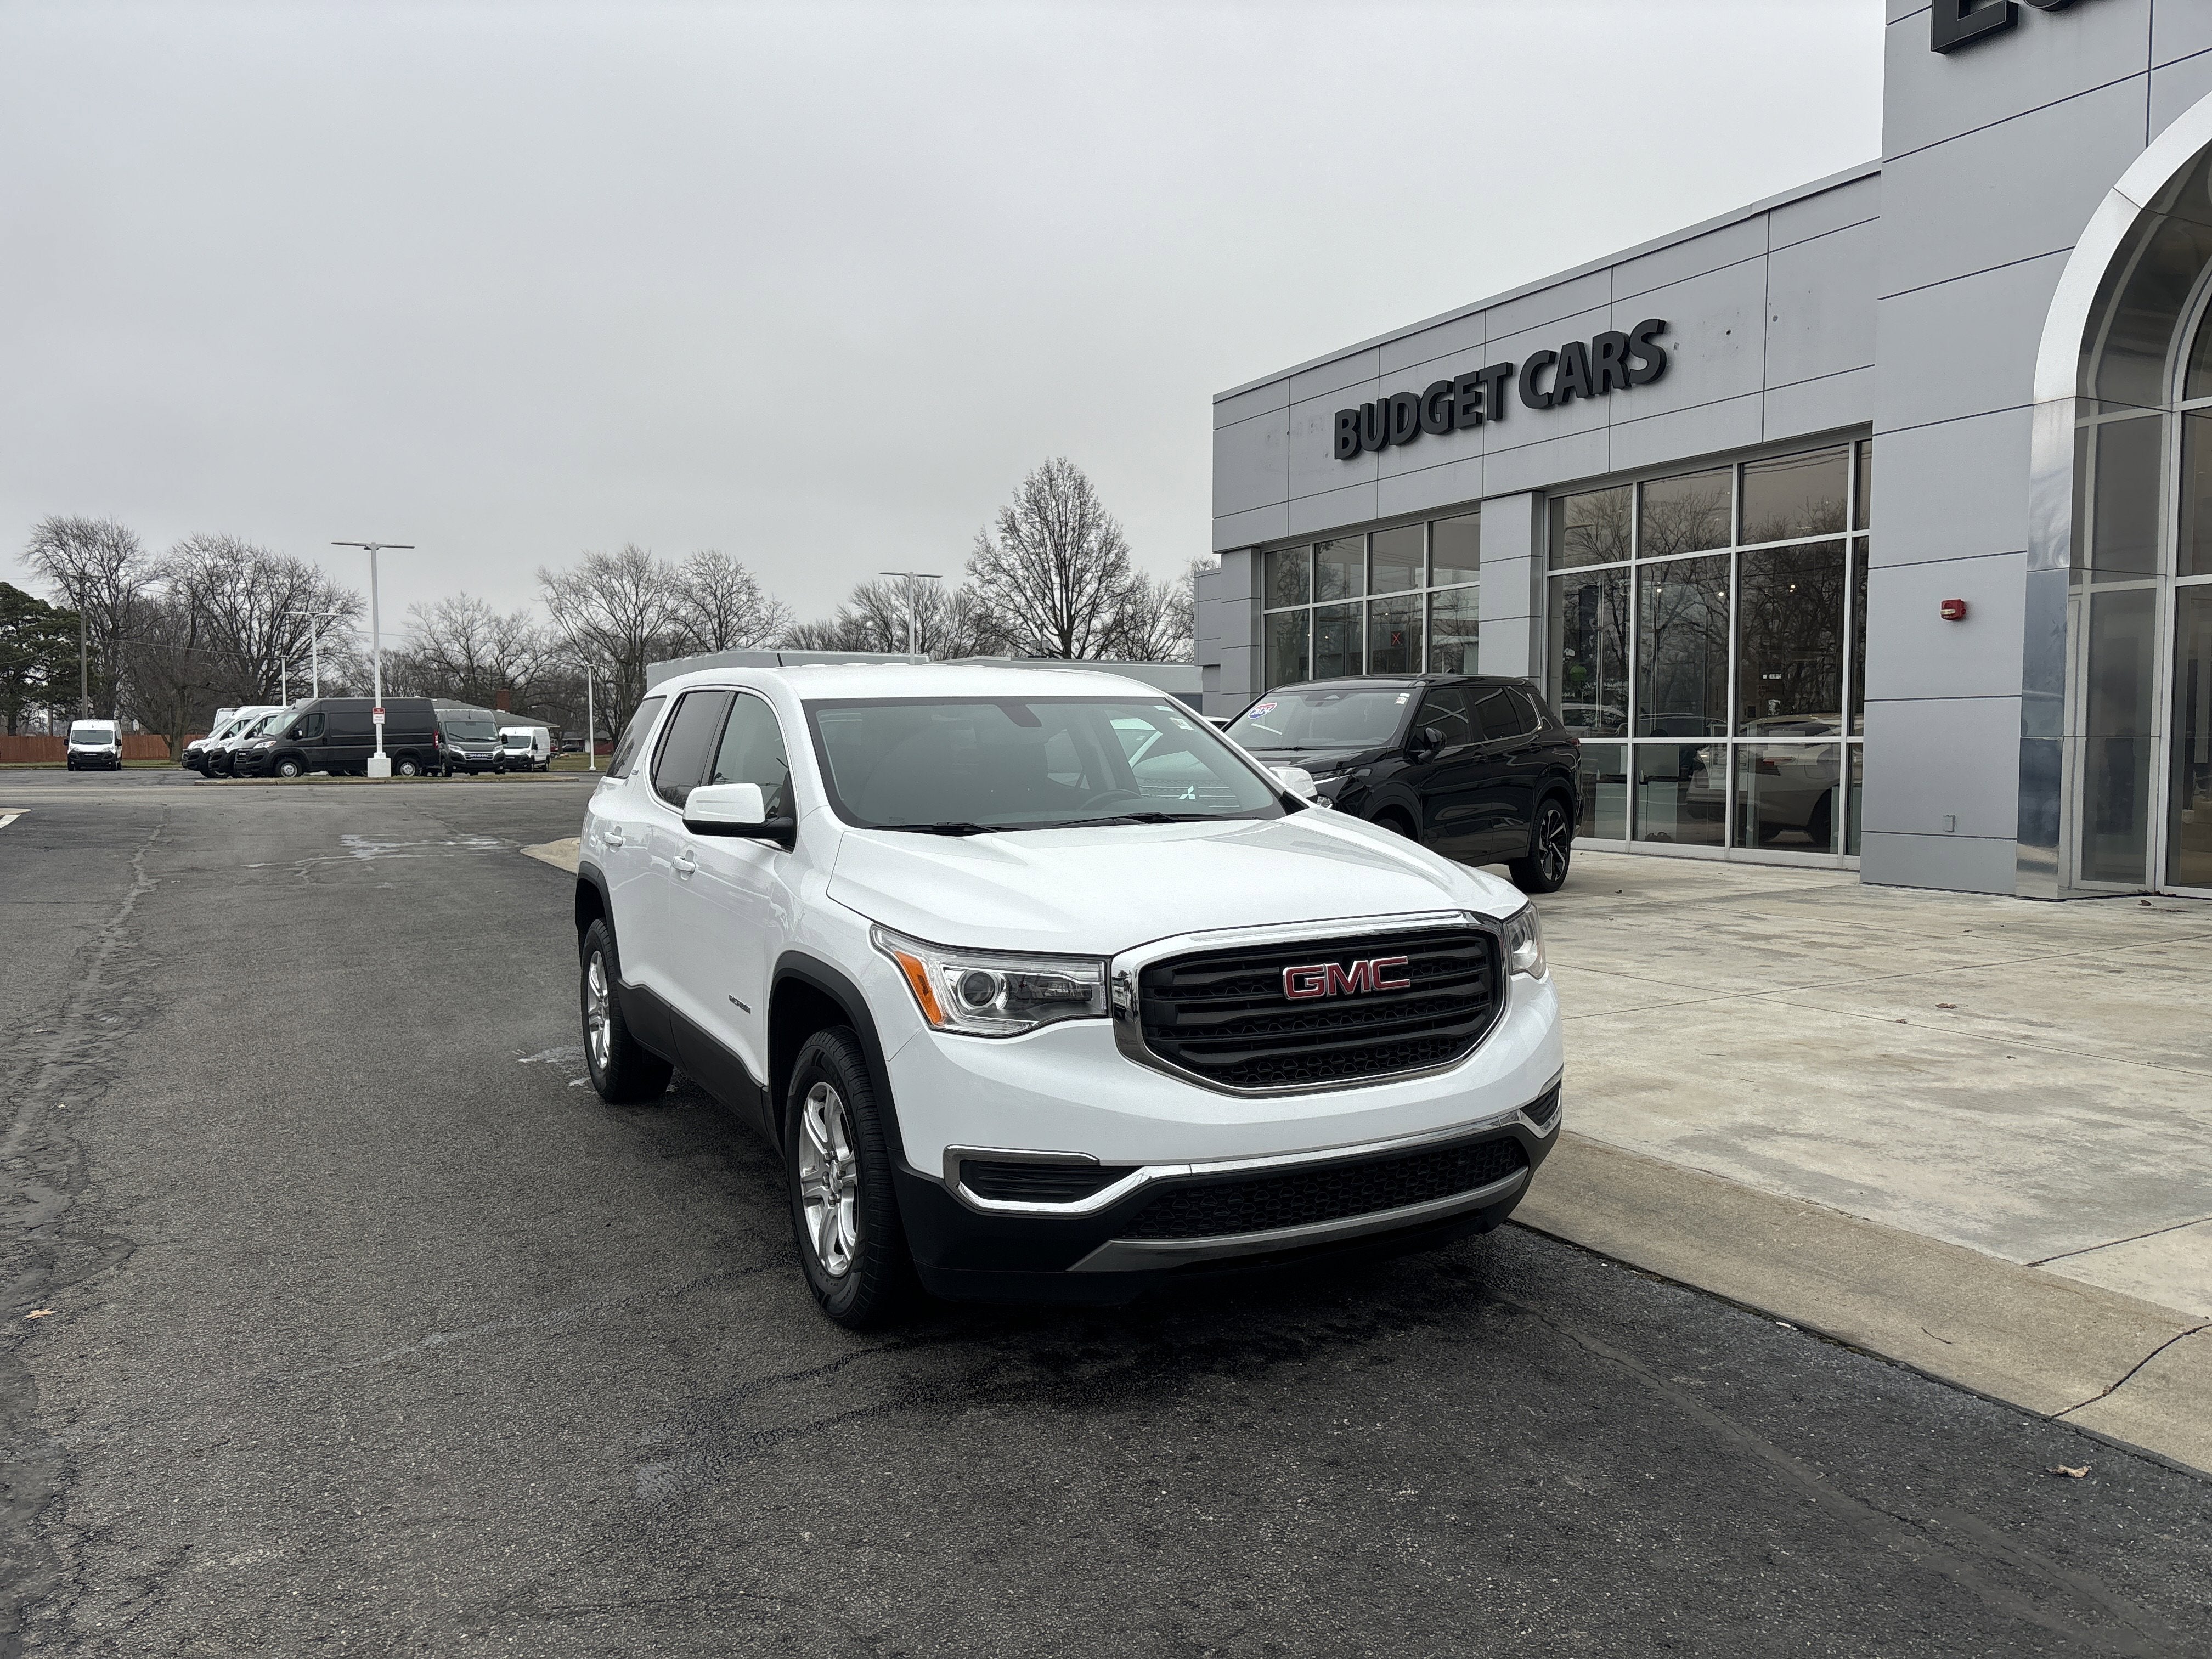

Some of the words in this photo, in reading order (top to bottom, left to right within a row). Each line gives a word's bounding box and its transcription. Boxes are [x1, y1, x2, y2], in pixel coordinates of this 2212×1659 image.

[1334, 362, 1513, 460] BUDGET
[1519, 318, 1667, 409] CARS
[1283, 956, 1410, 1000] GMC
